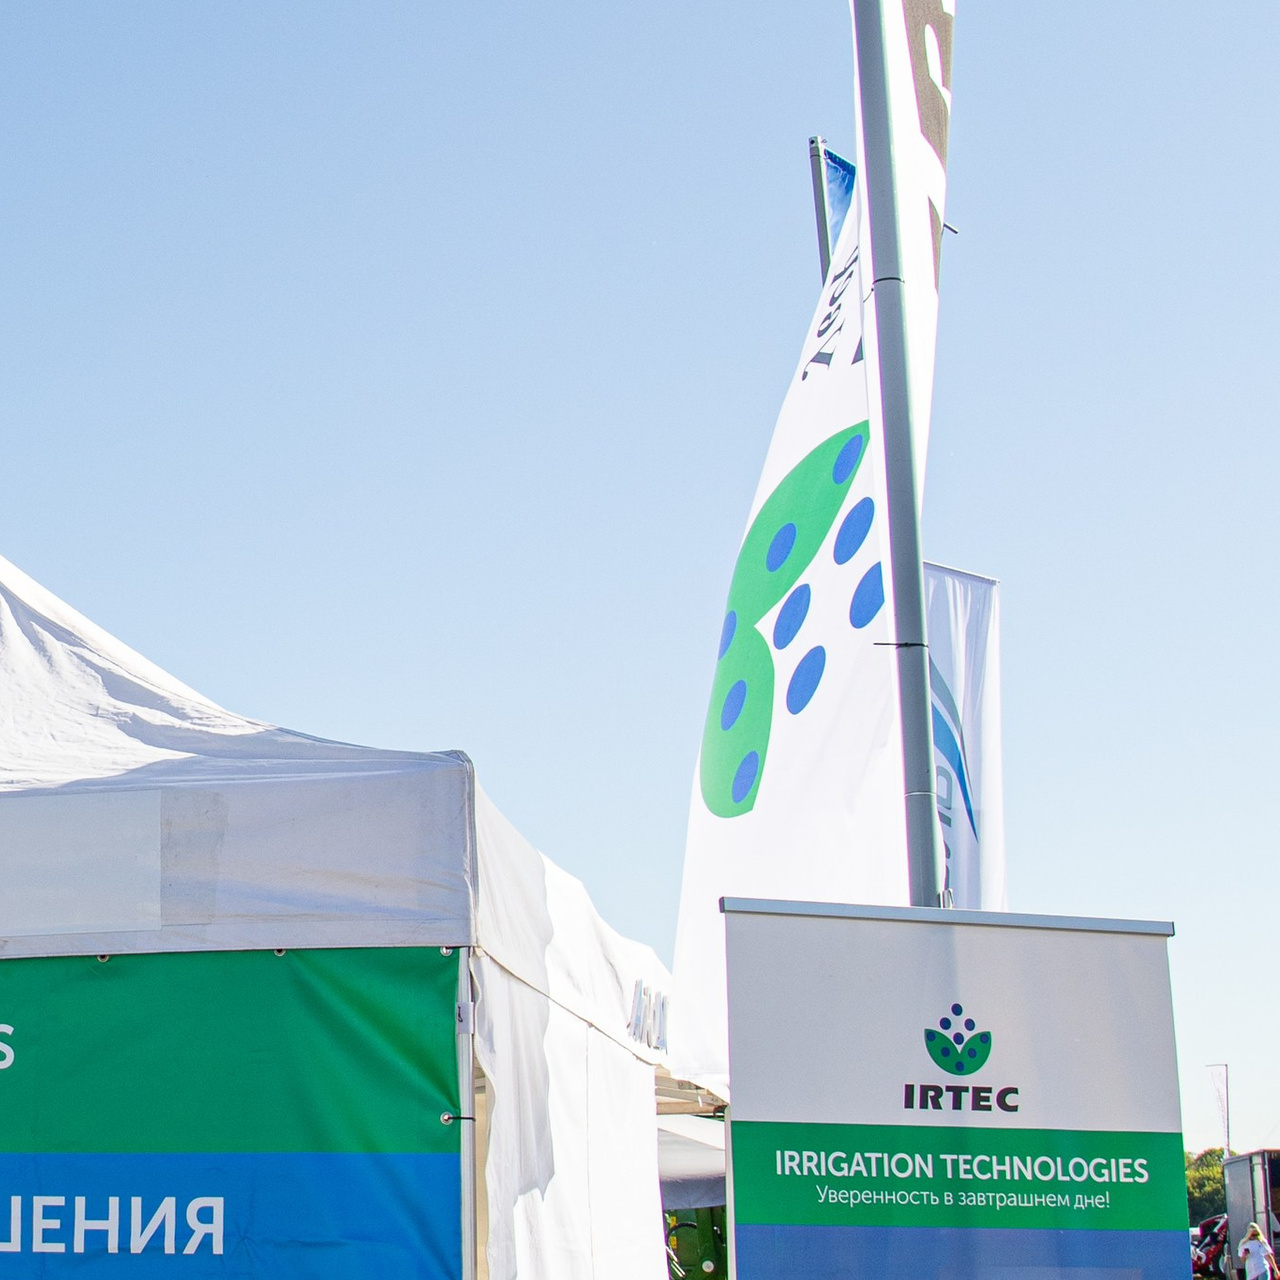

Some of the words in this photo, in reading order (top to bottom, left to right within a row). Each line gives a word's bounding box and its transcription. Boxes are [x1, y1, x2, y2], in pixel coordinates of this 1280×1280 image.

[903, 1083, 1020, 1113] IRTEC
[776, 1150, 934, 1179] IRRIGATION
[939, 1154, 1149, 1184] TECHNOLOGIES
[816, 1185, 940, 1208] Уверенность
[944, 1192, 954, 1205] в
[958, 1192, 1070, 1211] завтрашнем
[1073, 1191, 1110, 1210] дне!
